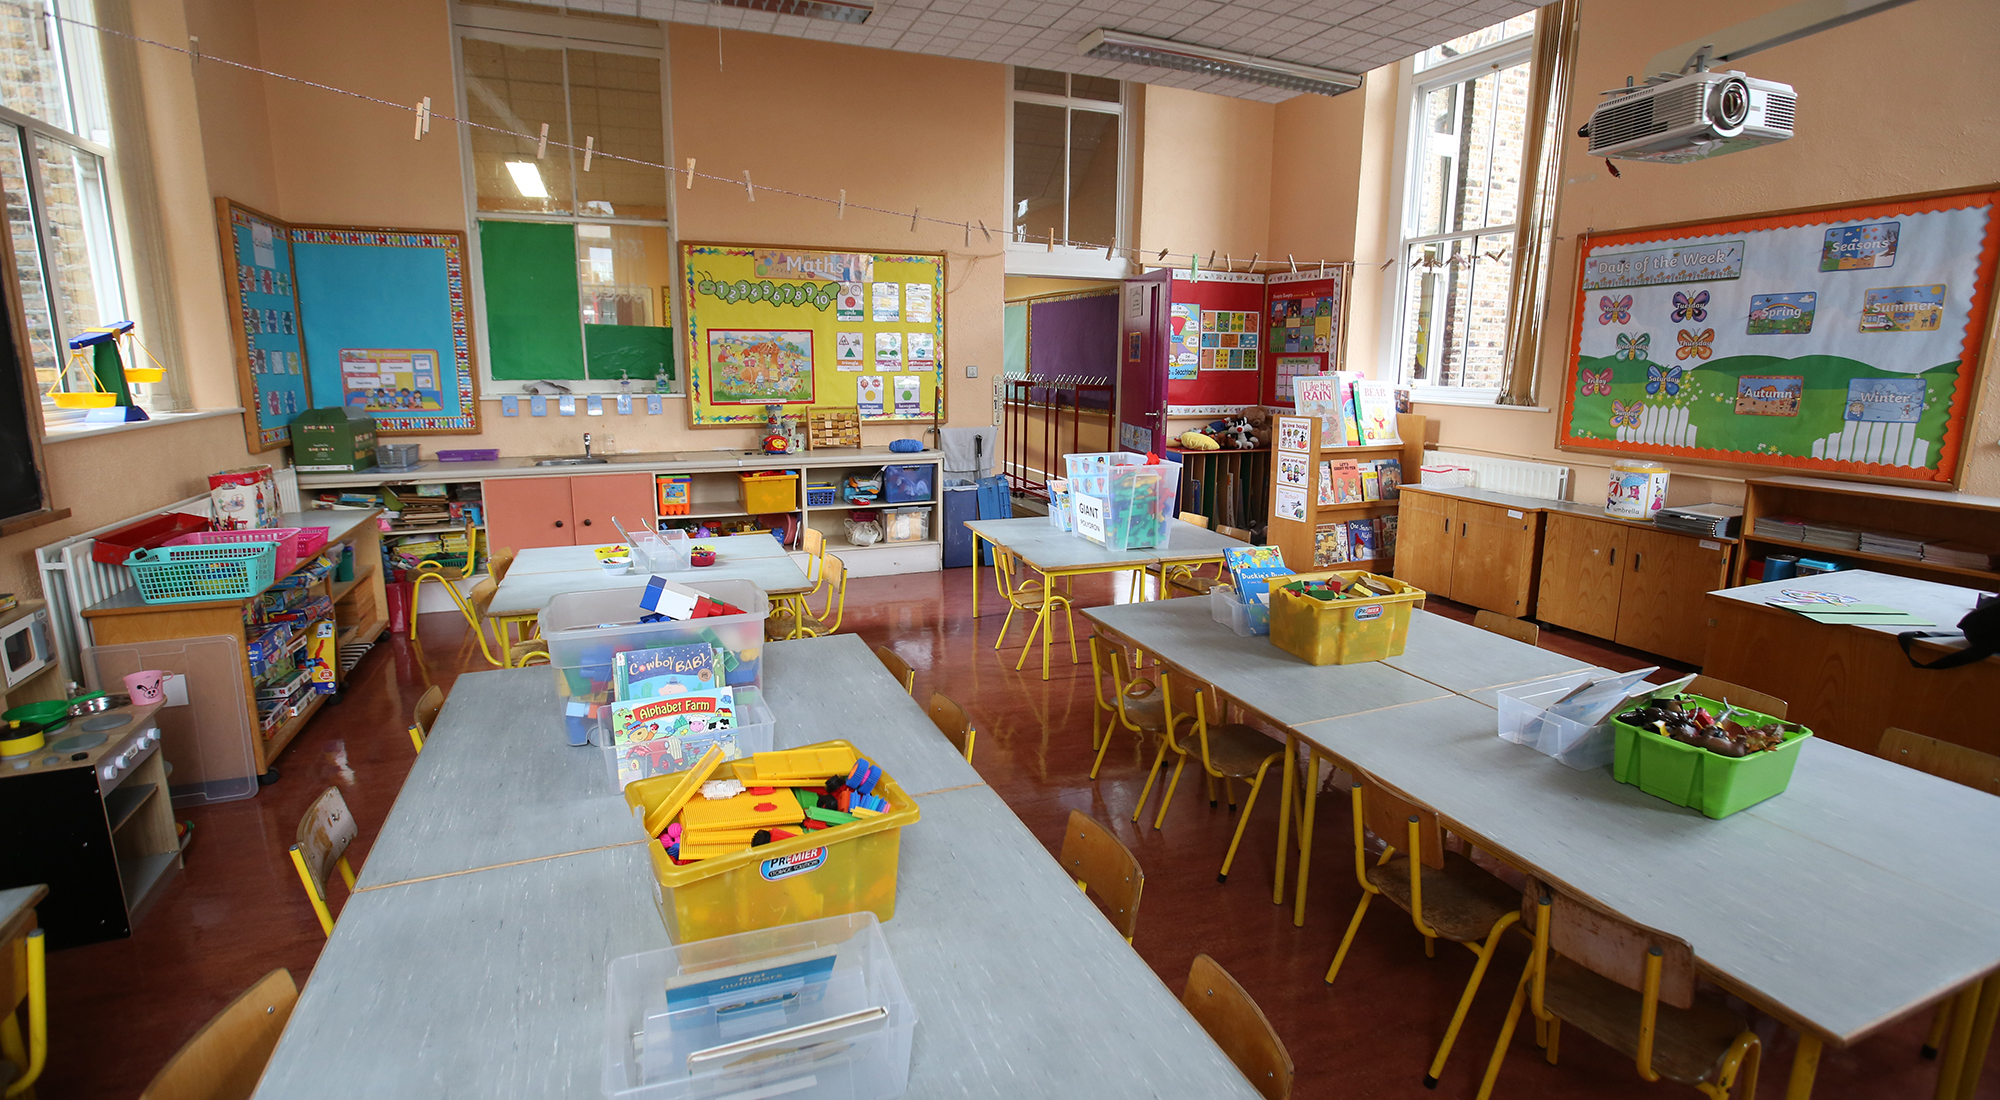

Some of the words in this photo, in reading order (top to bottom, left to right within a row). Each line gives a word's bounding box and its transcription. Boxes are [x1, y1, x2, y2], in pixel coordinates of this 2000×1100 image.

[1831, 239, 1889, 252] Seasons
[786, 255, 845, 275] Maths
[1599, 261, 1631, 276] Days
[1634, 256, 1650, 274] of
[1653, 255, 1678, 269] the
[1683, 249, 1726, 266] Week
[729, 289, 737, 299] 2
[740, 284, 747, 294] 3
[750, 287, 758, 298] 4
[763, 285, 770, 295] 5
[773, 290, 780, 300] 6
[784, 288, 791, 298] 7
[794, 290, 802, 300] 8
[806, 286, 813, 297] 9
[816, 294, 828, 305] 10
[1676, 302, 1705, 310] Tuesday
[1872, 301, 1936, 313] Summer
[1761, 306, 1802, 319] Spring
[1648, 375, 1679, 383] Saturday
[1320, 381, 1332, 391] the
[1303, 391, 1332, 400] RAIN
[1364, 388, 1386, 397] BEAR
[1744, 388, 1793, 399] Autumn
[1860, 392, 1912, 404] Winter
[1615, 410, 1639, 418] Sunday
[1078, 502, 1099, 519] GIANT
[1613, 507, 1640, 515] umbrella
[1349, 522, 1359, 530] One
[629, 653, 676, 676] Cowboy
[675, 652, 710, 673] BABY
[639, 701, 682, 720] Alphabet
[685, 699, 710, 712] Farm
[770, 848, 819, 868] PREMIER
[720, 973, 783, 990] numbers
[739, 972, 766, 982] first
